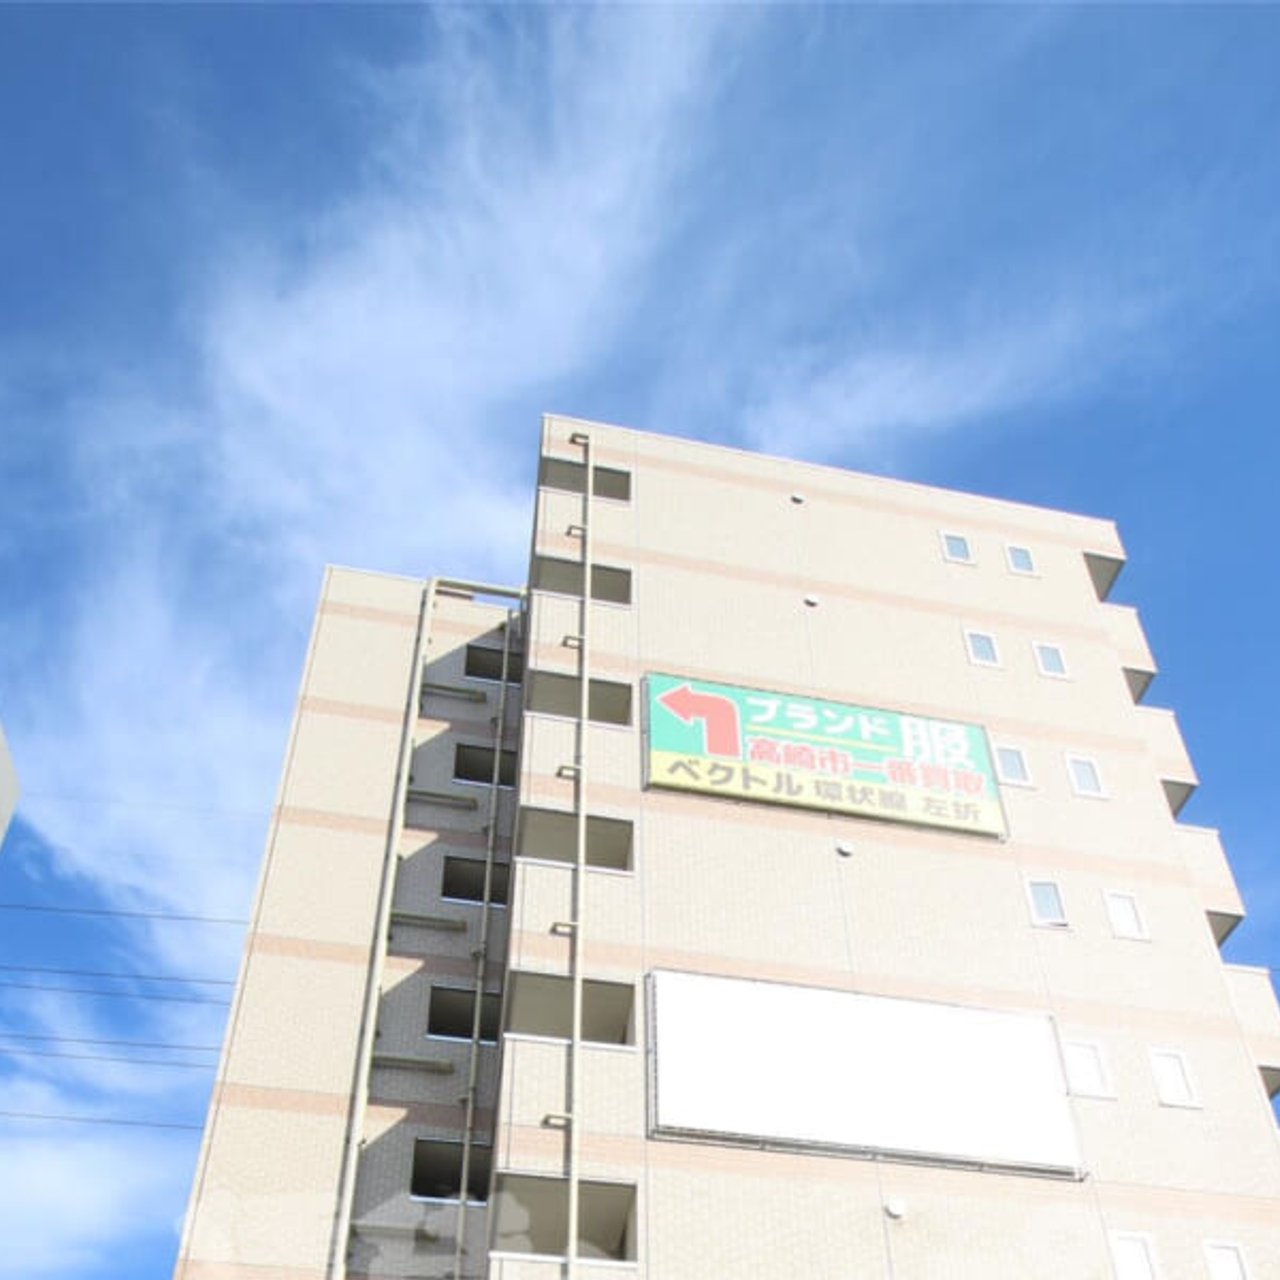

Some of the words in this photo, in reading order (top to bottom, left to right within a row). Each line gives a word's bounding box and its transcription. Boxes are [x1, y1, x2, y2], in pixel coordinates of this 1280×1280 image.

[745, 696, 893, 741] ブランド
[899, 714, 974, 768] 服
[667, 759, 804, 798] ベクトル
